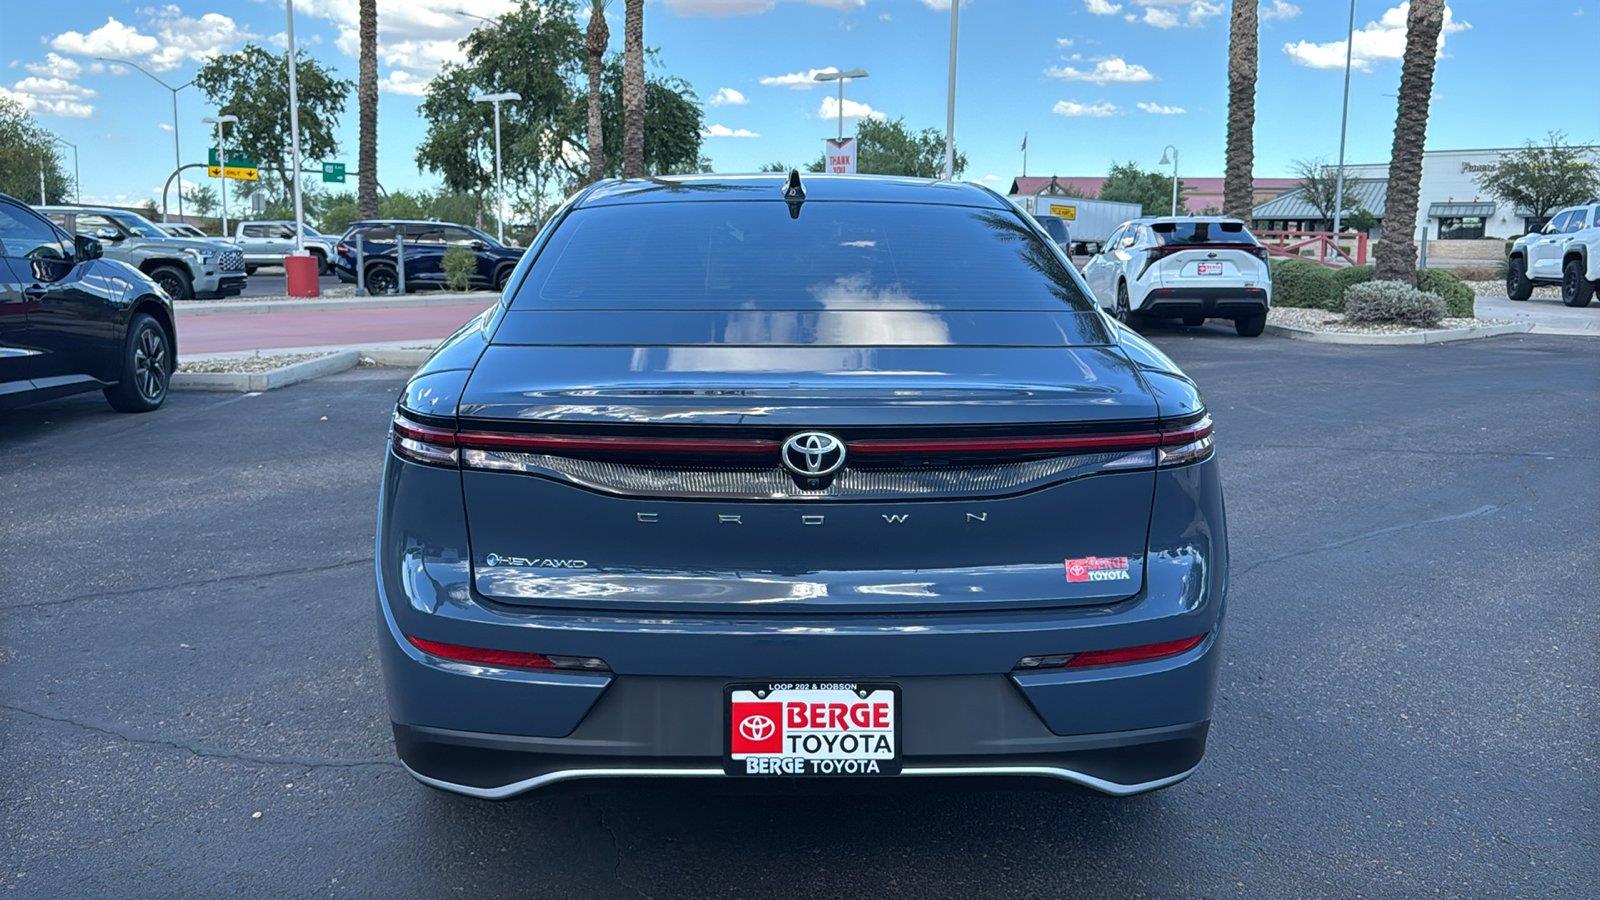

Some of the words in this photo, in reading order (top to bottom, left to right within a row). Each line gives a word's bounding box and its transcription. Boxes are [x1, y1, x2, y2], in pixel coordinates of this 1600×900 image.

[637, 511, 989, 525] CROWN
[1086, 557, 1128, 570] BERGE
[1088, 571, 1130, 580] TOYOTA
[787, 702, 890, 731] BERGE
[787, 734, 892, 754] TOYOTA
[746, 757, 805, 775] BERGE
[810, 759, 880, 774] TOYOTA
